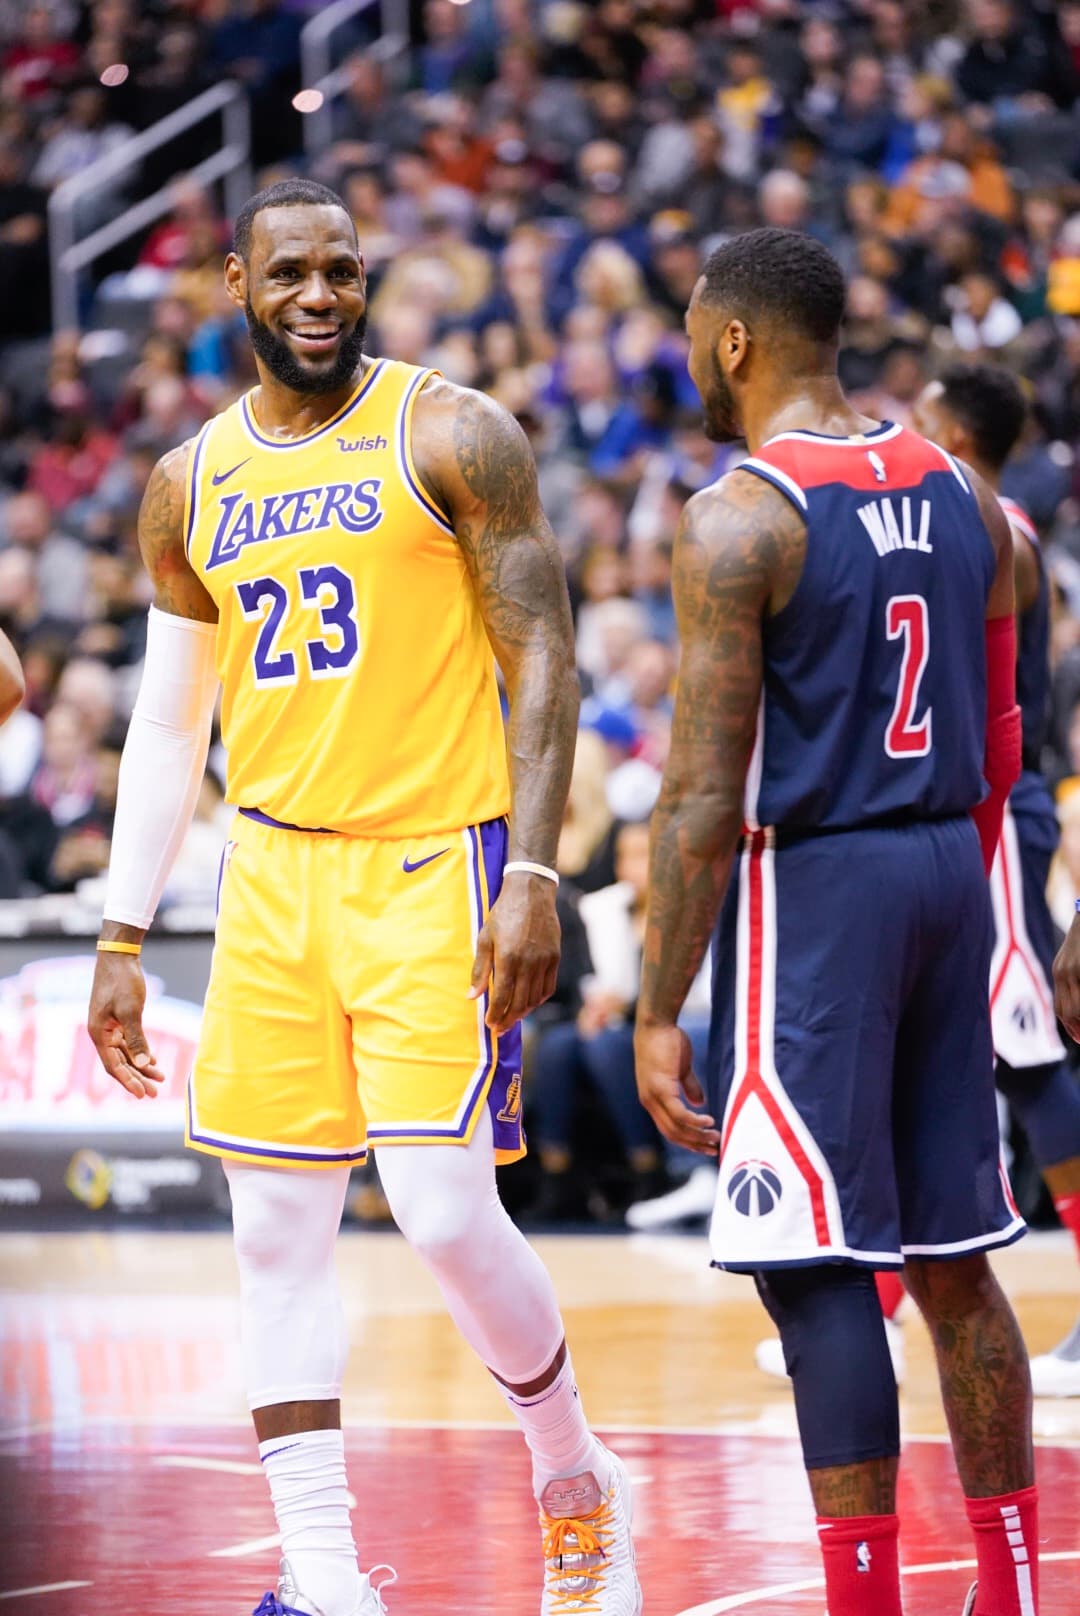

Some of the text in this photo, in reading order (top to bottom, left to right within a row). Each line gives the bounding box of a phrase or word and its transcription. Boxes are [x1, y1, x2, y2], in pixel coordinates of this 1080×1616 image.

[336, 435, 387, 452] wish
[205, 478, 384, 571] LAKERS
[856, 496, 933, 557] WALL
[234, 564, 359, 689] 23
[884, 594, 932, 759] 2
